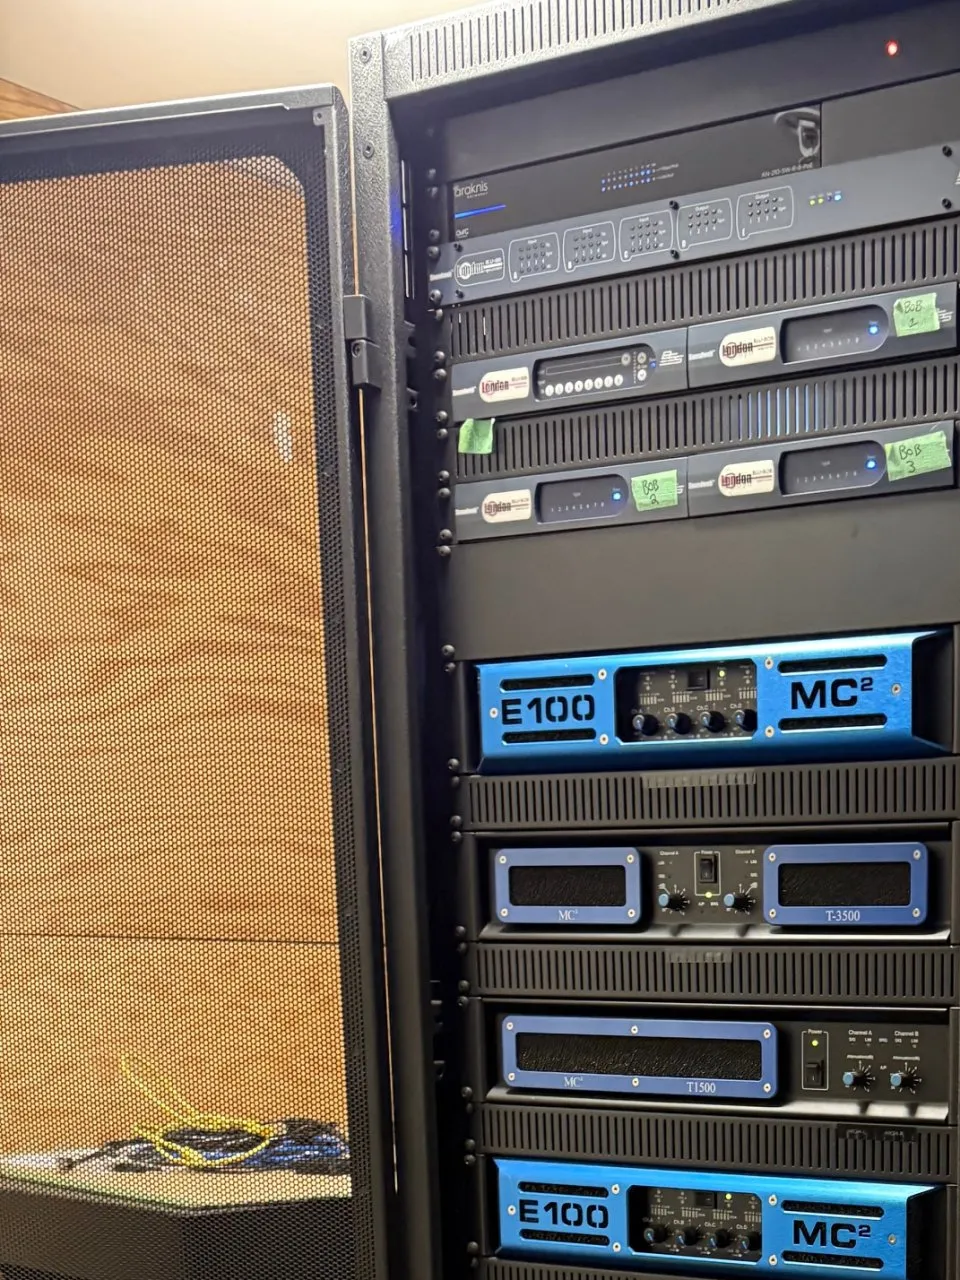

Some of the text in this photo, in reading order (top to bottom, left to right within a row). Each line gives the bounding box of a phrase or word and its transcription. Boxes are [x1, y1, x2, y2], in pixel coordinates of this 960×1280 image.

[722, 341, 754, 359] London
[481, 379, 510, 396] London
[907, 460, 917, 473] 3
[720, 472, 752, 489] London
[650, 494, 659, 505] 2
[484, 500, 512, 517] London
[501, 694, 596, 725] E100
[825, 909, 861, 922] T-3500
[686, 1080, 717, 1094] T1500
[518, 1199, 610, 1229] E100
